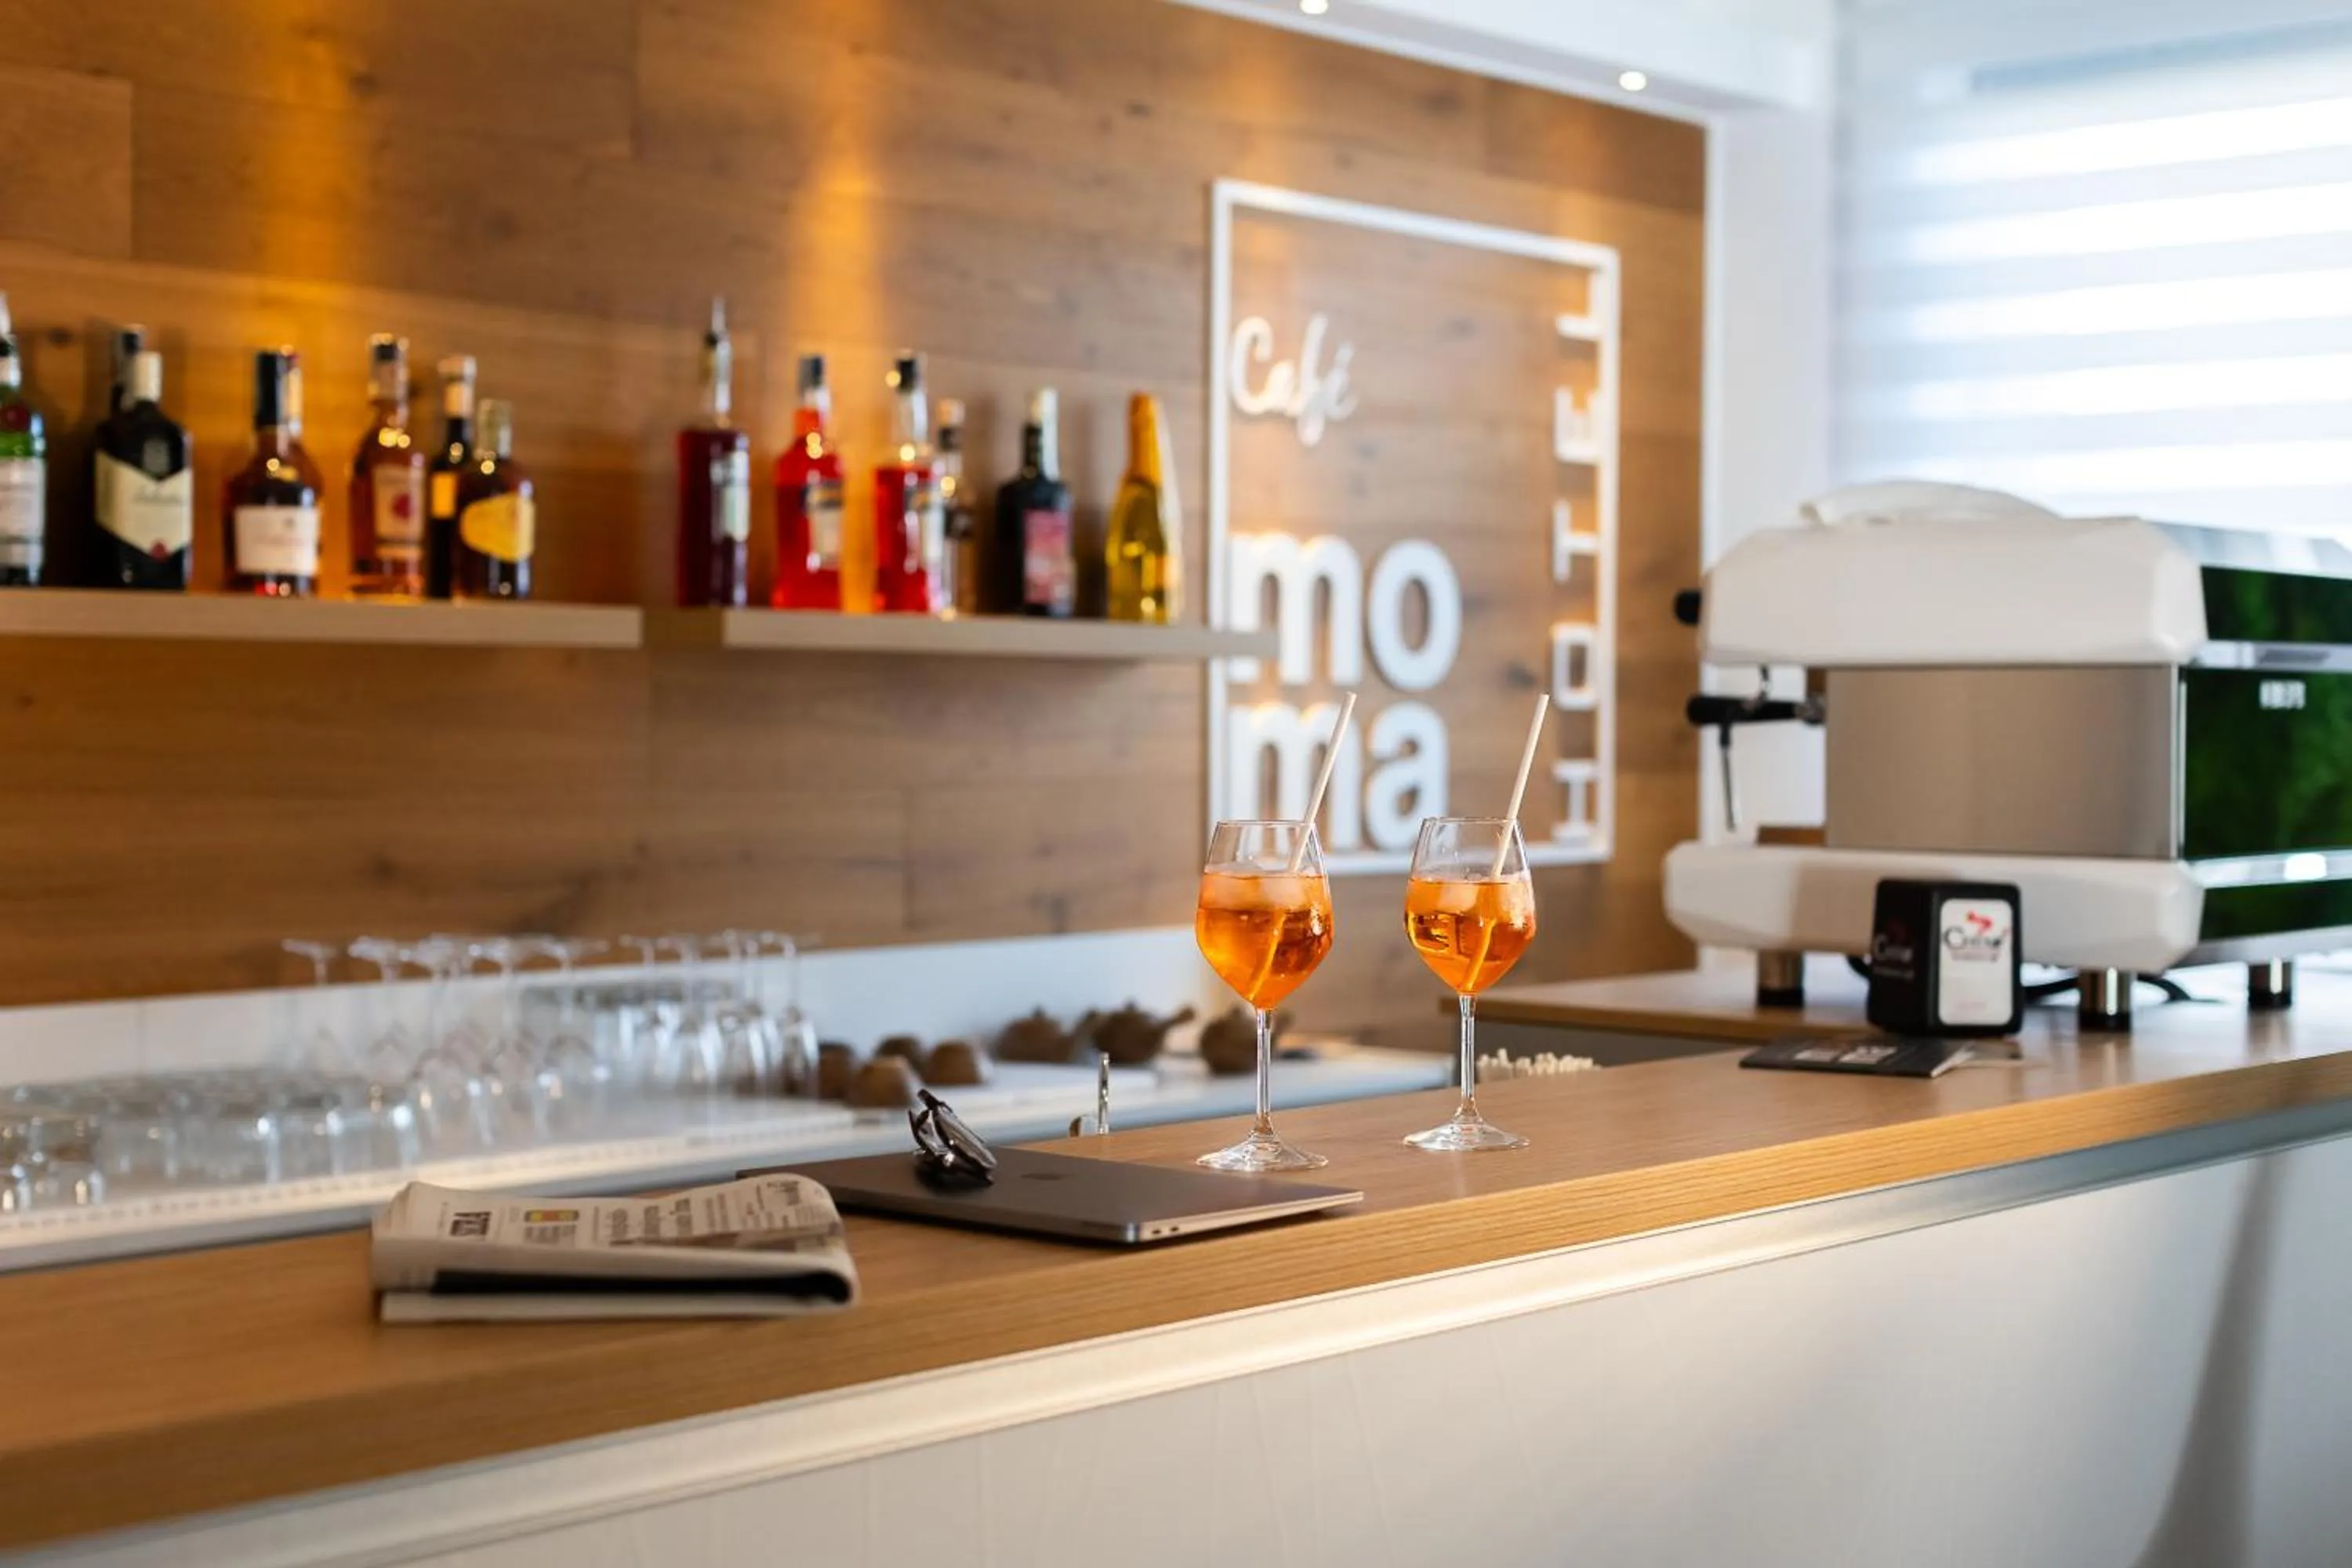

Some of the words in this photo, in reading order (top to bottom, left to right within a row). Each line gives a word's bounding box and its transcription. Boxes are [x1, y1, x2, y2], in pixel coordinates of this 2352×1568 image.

[1232, 314, 1359, 446] Café
[1229, 532, 1462, 691] mo
[1552, 269, 1602, 842] HOTEL
[1229, 701, 1450, 851] ma
